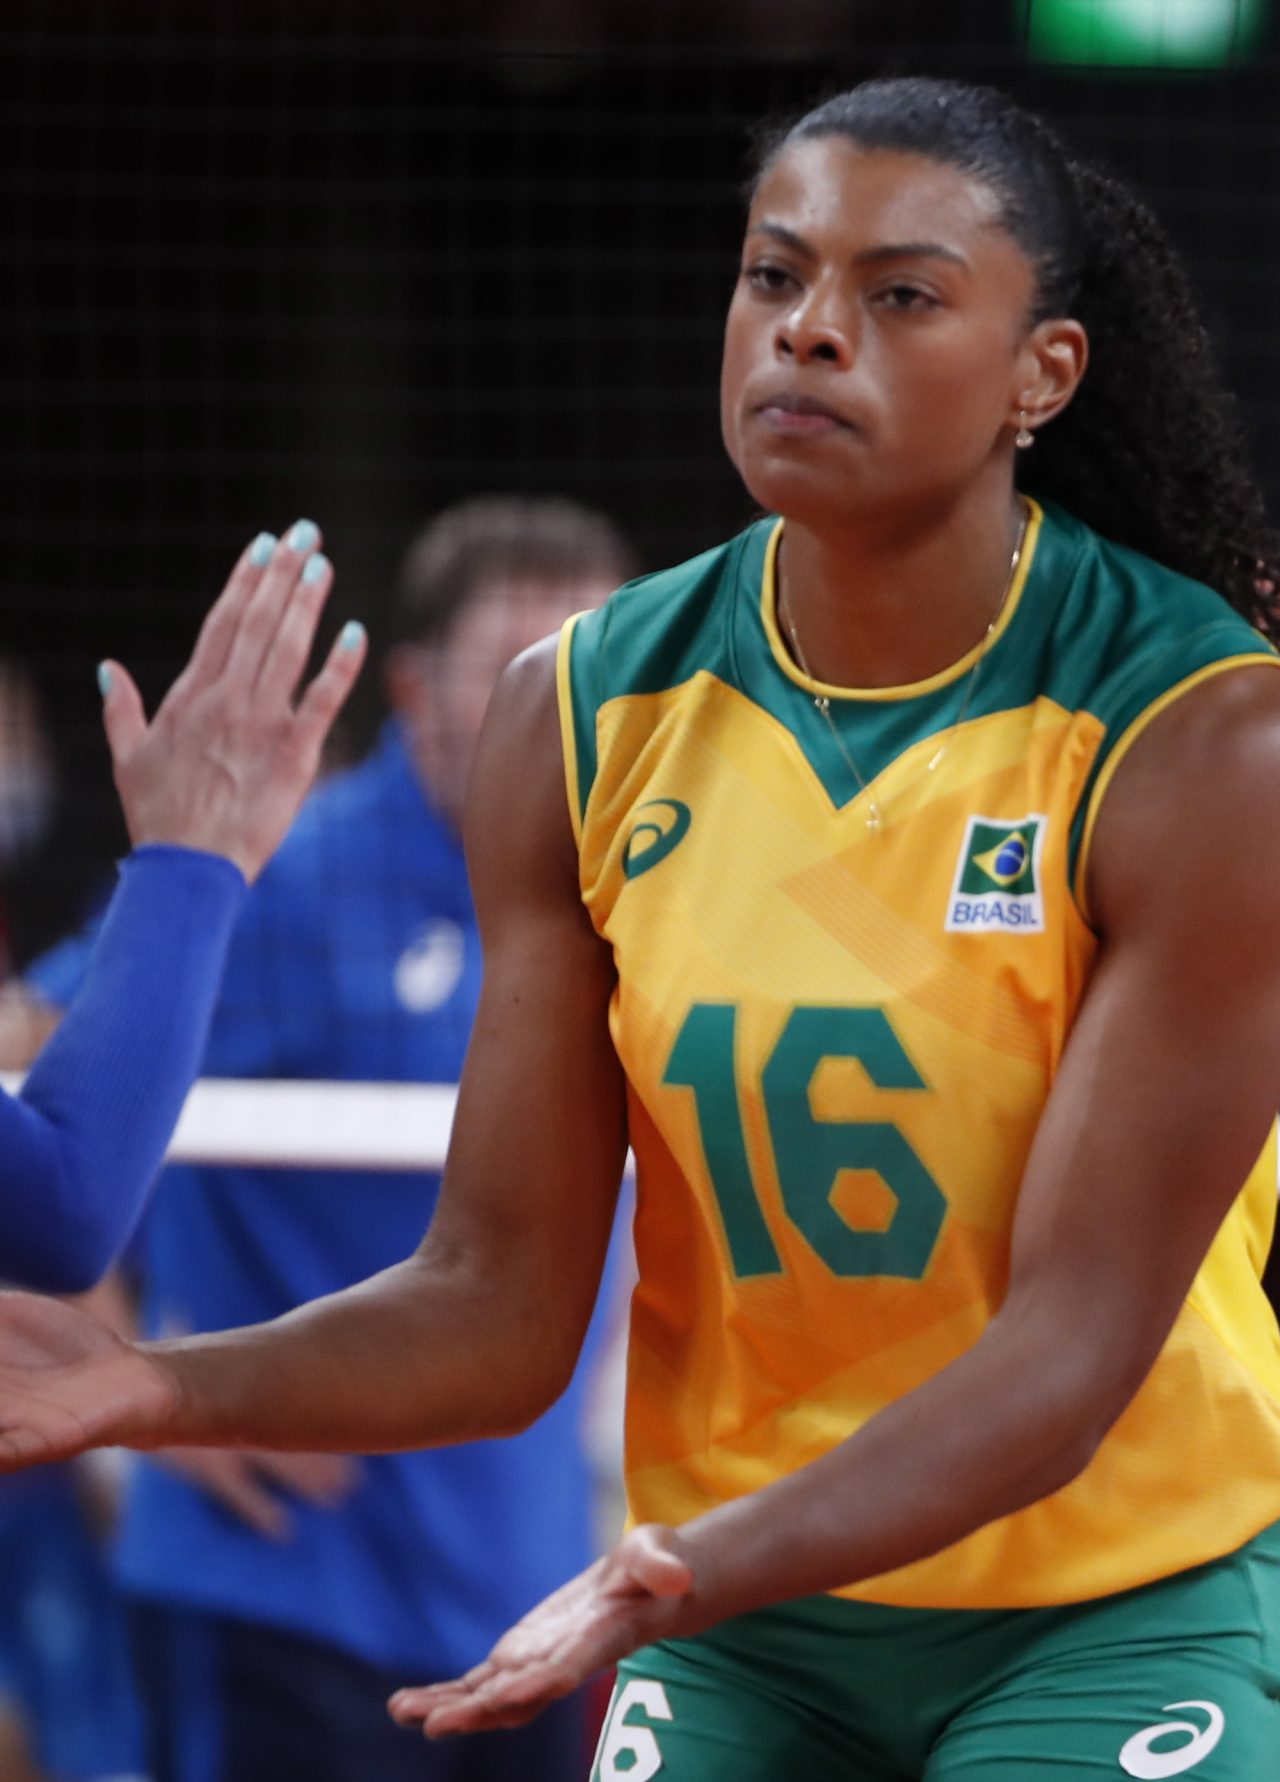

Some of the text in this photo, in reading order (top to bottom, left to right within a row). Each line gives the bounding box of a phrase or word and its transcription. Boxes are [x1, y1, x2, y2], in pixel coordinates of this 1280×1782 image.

[953, 900, 1038, 925] BRASIL
[661, 1003, 949, 1280] 16
[588, 1679, 674, 1782] 6
